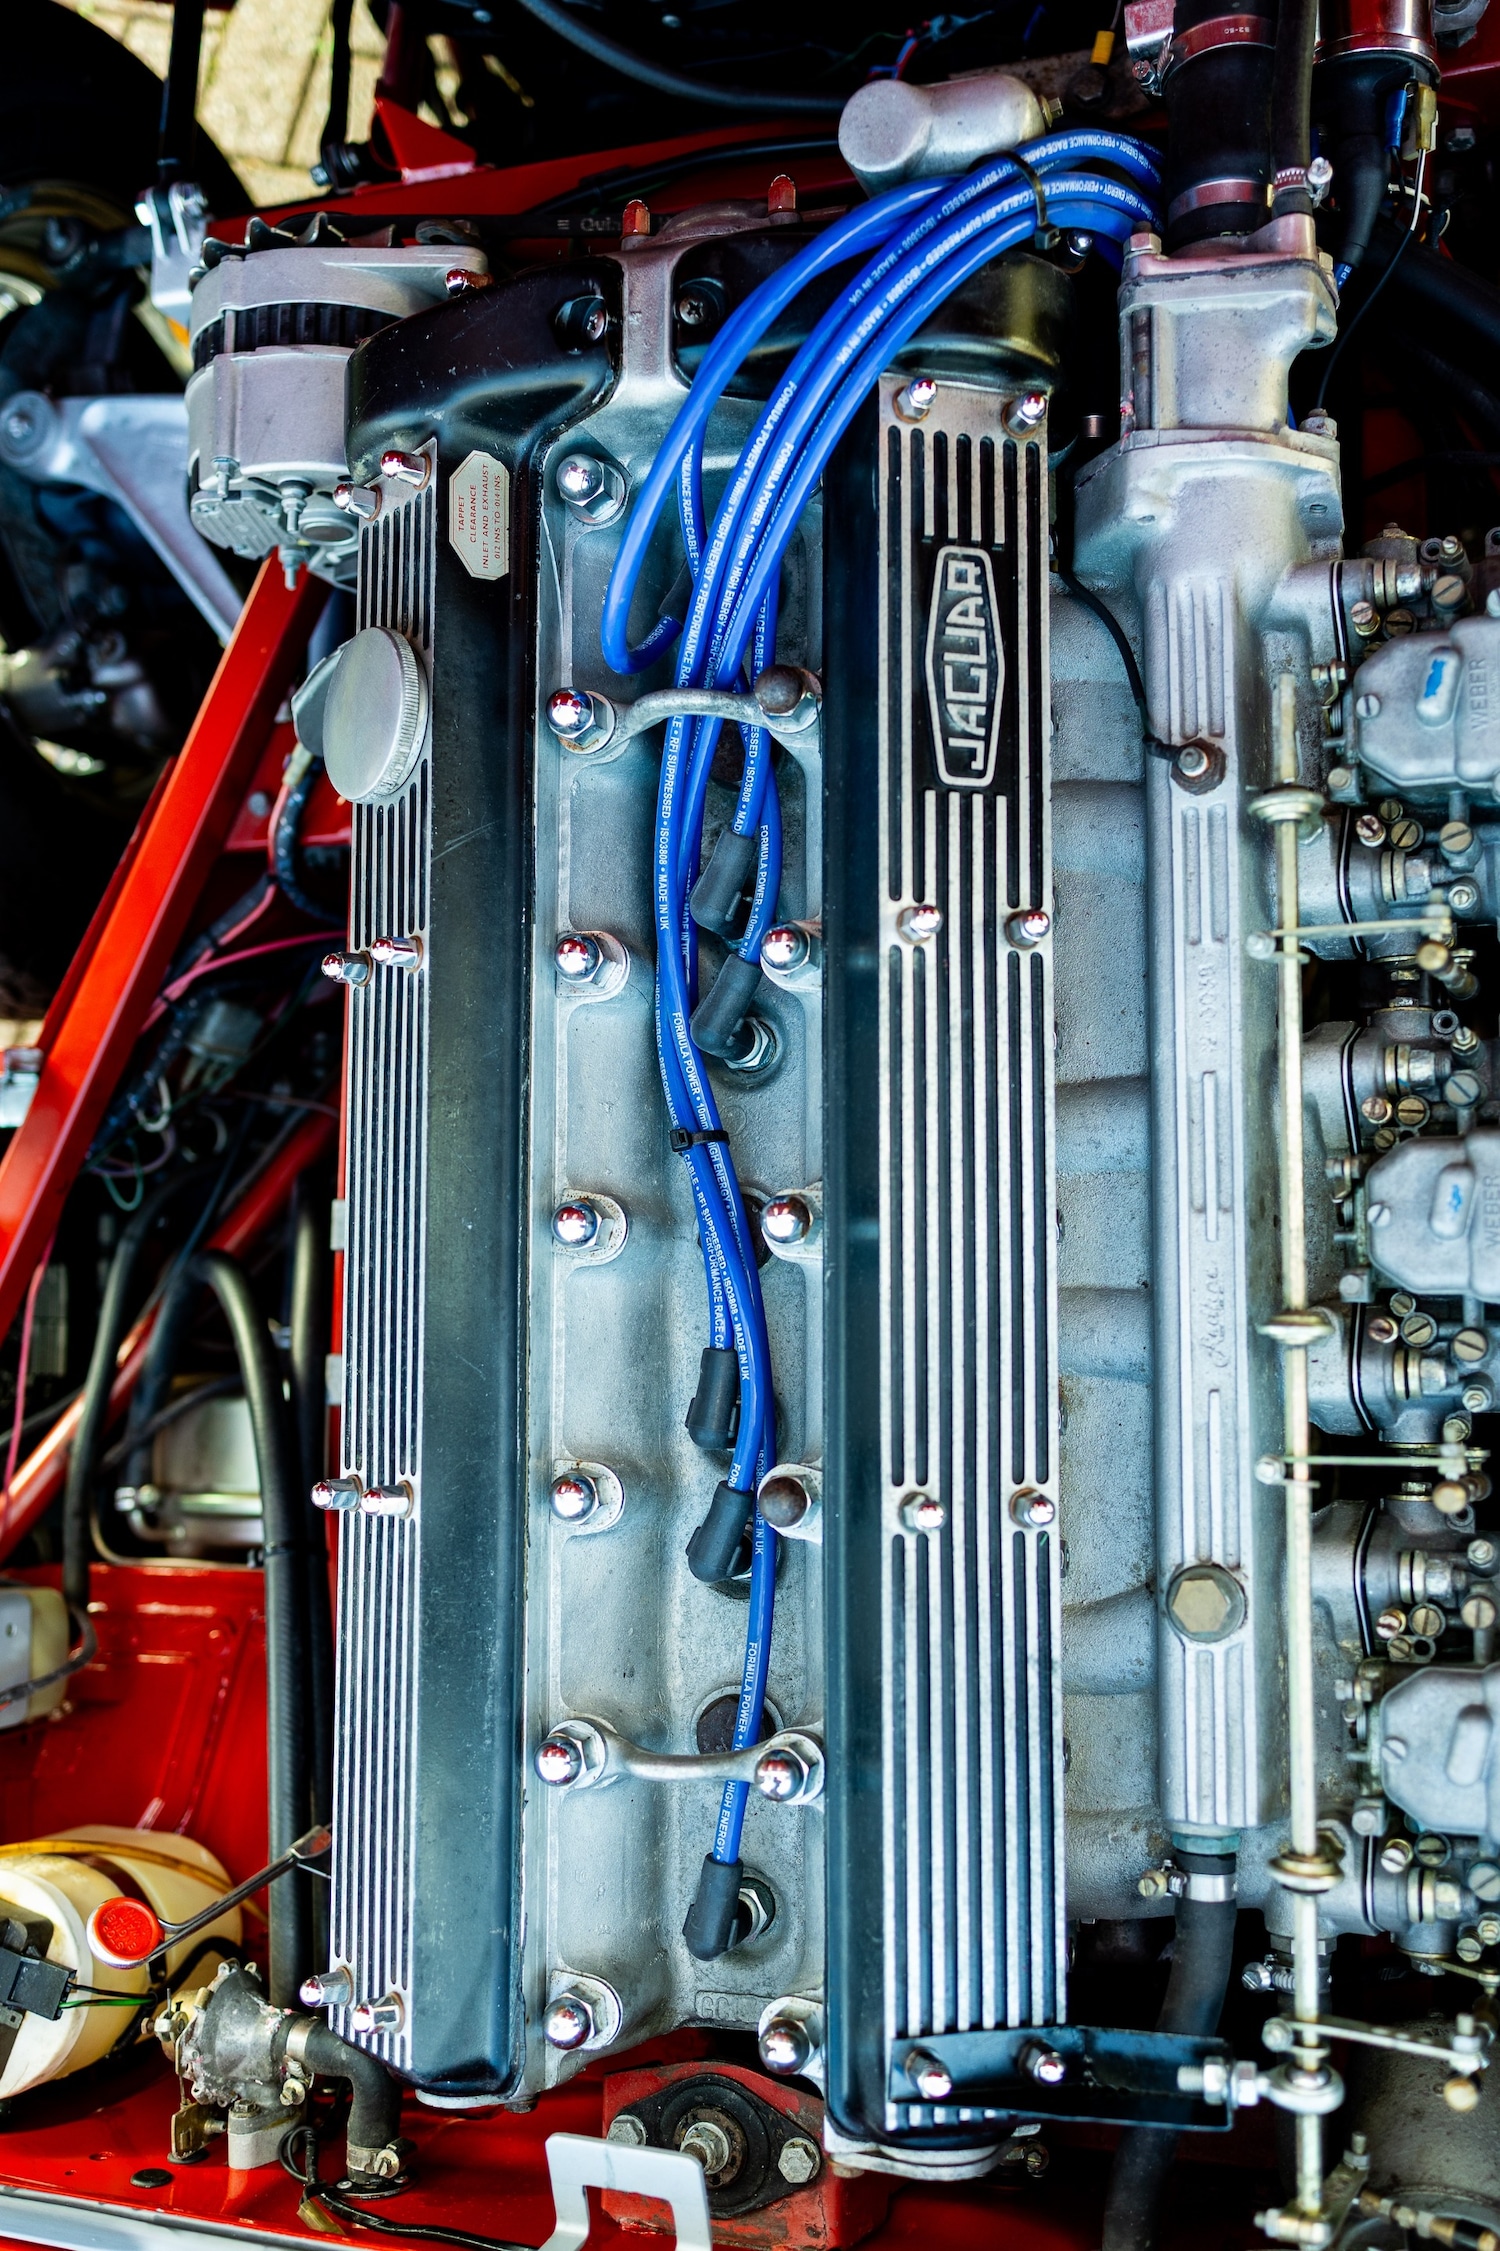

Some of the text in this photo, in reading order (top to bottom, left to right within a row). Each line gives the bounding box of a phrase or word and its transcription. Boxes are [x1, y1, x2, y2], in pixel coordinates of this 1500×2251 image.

[1068, 135, 1116, 149] PERFORMANCE
[941, 170, 998, 217] SUPPRESSED
[1051, 180, 1100, 194] PERFORMANCE
[1103, 183, 1127, 200] ENERGY
[925, 214, 981, 267] SUPPRESSED
[871, 252, 898, 282] MADE
[849, 288, 863, 306] UK
[861, 277, 874, 292] IN
[857, 304, 884, 339] MADE
[836, 346, 853, 365] UK
[848, 333, 862, 350] IN
[763, 380, 798, 431] FORMULA
[744, 430, 771, 468] POWER
[764, 441, 795, 491] FORMULA
[729, 476, 747, 506] 10mm
[494, 511, 501, 524] TO
[683, 498, 694, 526] RACE
[750, 490, 773, 527] POWER
[716, 512, 734, 539] HIGH
[686, 526, 699, 559] CABLE
[737, 532, 755, 560] 10mm
[703, 540, 723, 582] ENERGY
[725, 566, 743, 589] HIGH
[716, 589, 737, 628] ENERGY
[682, 589, 709, 664] PERFORMANCE
[754, 634, 764, 668] CABLE
[943, 559, 988, 771] JAGUAR
[679, 665, 691, 688] RAC
[1469, 657, 1488, 731] WEBER
[669, 736, 680, 753] RFI
[661, 754, 677, 819] SUPPRESSED
[741, 766, 755, 803] ISO3808
[659, 827, 670, 865] ISO3808
[759, 825, 769, 871] FORMULA
[658, 874, 667, 902] MADE
[754, 871, 767, 906] POWER
[659, 904, 668, 914] IN
[660, 916, 669, 931] UK
[745, 914, 760, 941] 10mm
[672, 1012, 709, 1131] FORMULA POWER 10mm
[713, 1163, 732, 1203] ENERGY
[696, 1191, 706, 1208] RFI
[701, 1208, 728, 1270] SUPPRESSED
[722, 1276, 739, 1315] ISO3808
[713, 1304, 725, 1333] RACE
[732, 1323, 747, 1352] MADE
[738, 1354, 748, 1365] IN
[740, 1366, 751, 1381] UK
[754, 1540, 764, 1555] UK
[755, 1528, 765, 1538] IN
[742, 1641, 758, 1692] FORMULA
[737, 1694, 752, 1733] POWER
[715, 1781, 737, 1853] HIGH ENERGY
